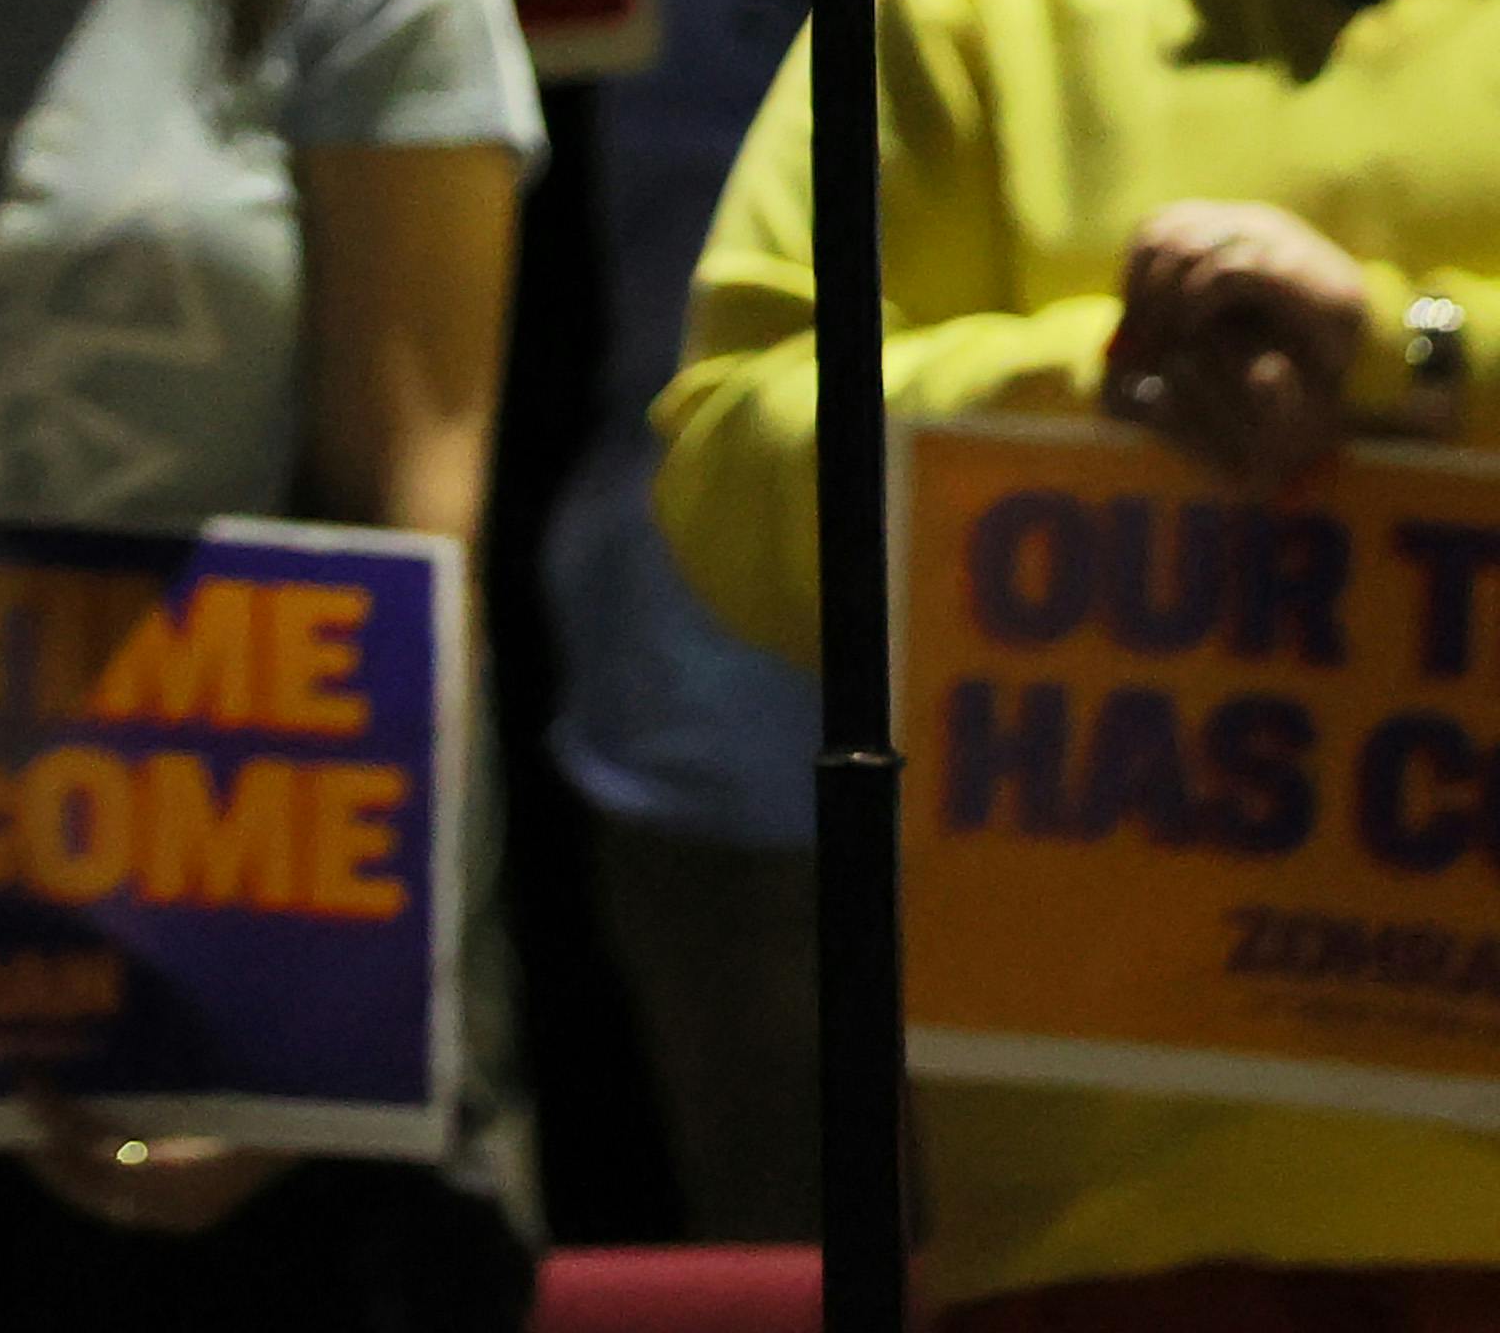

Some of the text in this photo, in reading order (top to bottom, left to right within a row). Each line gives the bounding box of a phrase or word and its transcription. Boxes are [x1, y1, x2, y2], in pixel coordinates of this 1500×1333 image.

[970, 489, 1352, 667] OUR
[940, 679, 1500, 888] HAS C
